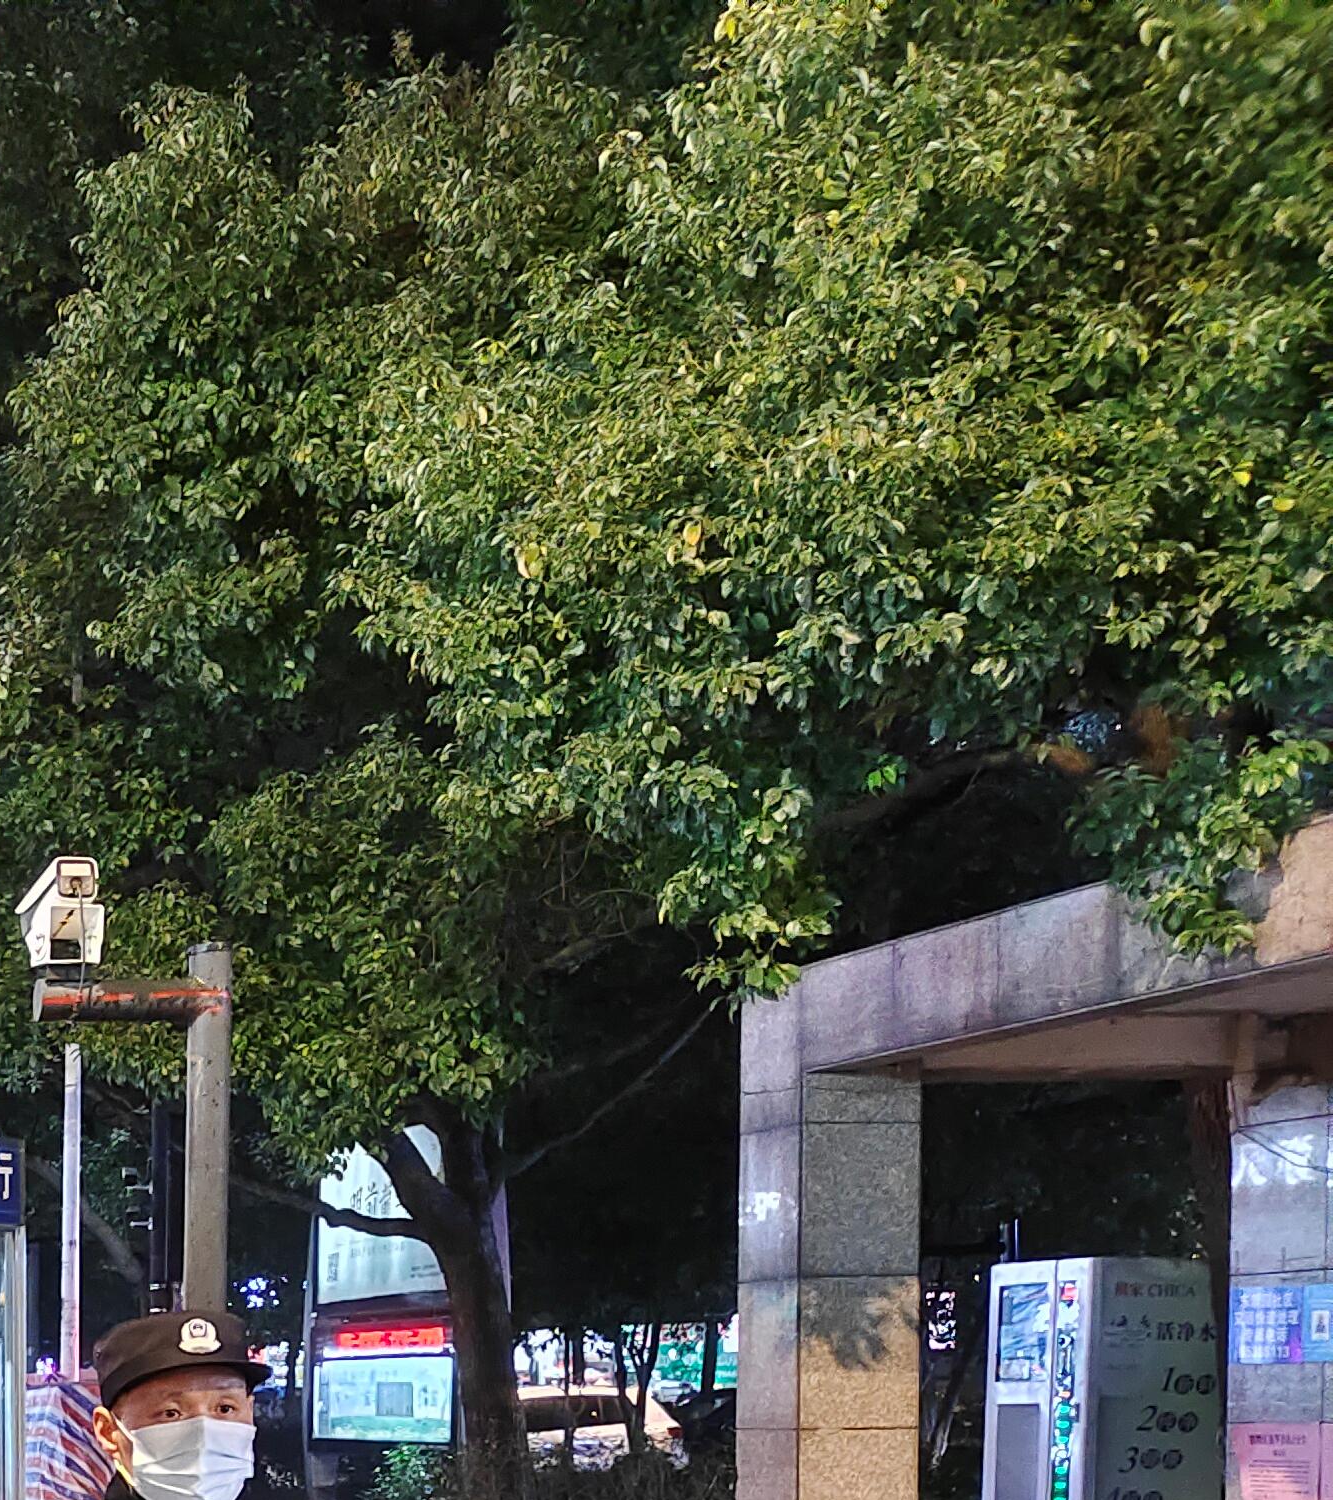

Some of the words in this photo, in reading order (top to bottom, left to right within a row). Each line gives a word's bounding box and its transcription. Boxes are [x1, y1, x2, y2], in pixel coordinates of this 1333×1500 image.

[1161, 1366, 1217, 1396] 100
[1136, 1404, 1200, 1433] 200
[1118, 1447, 1184, 1474] 300
